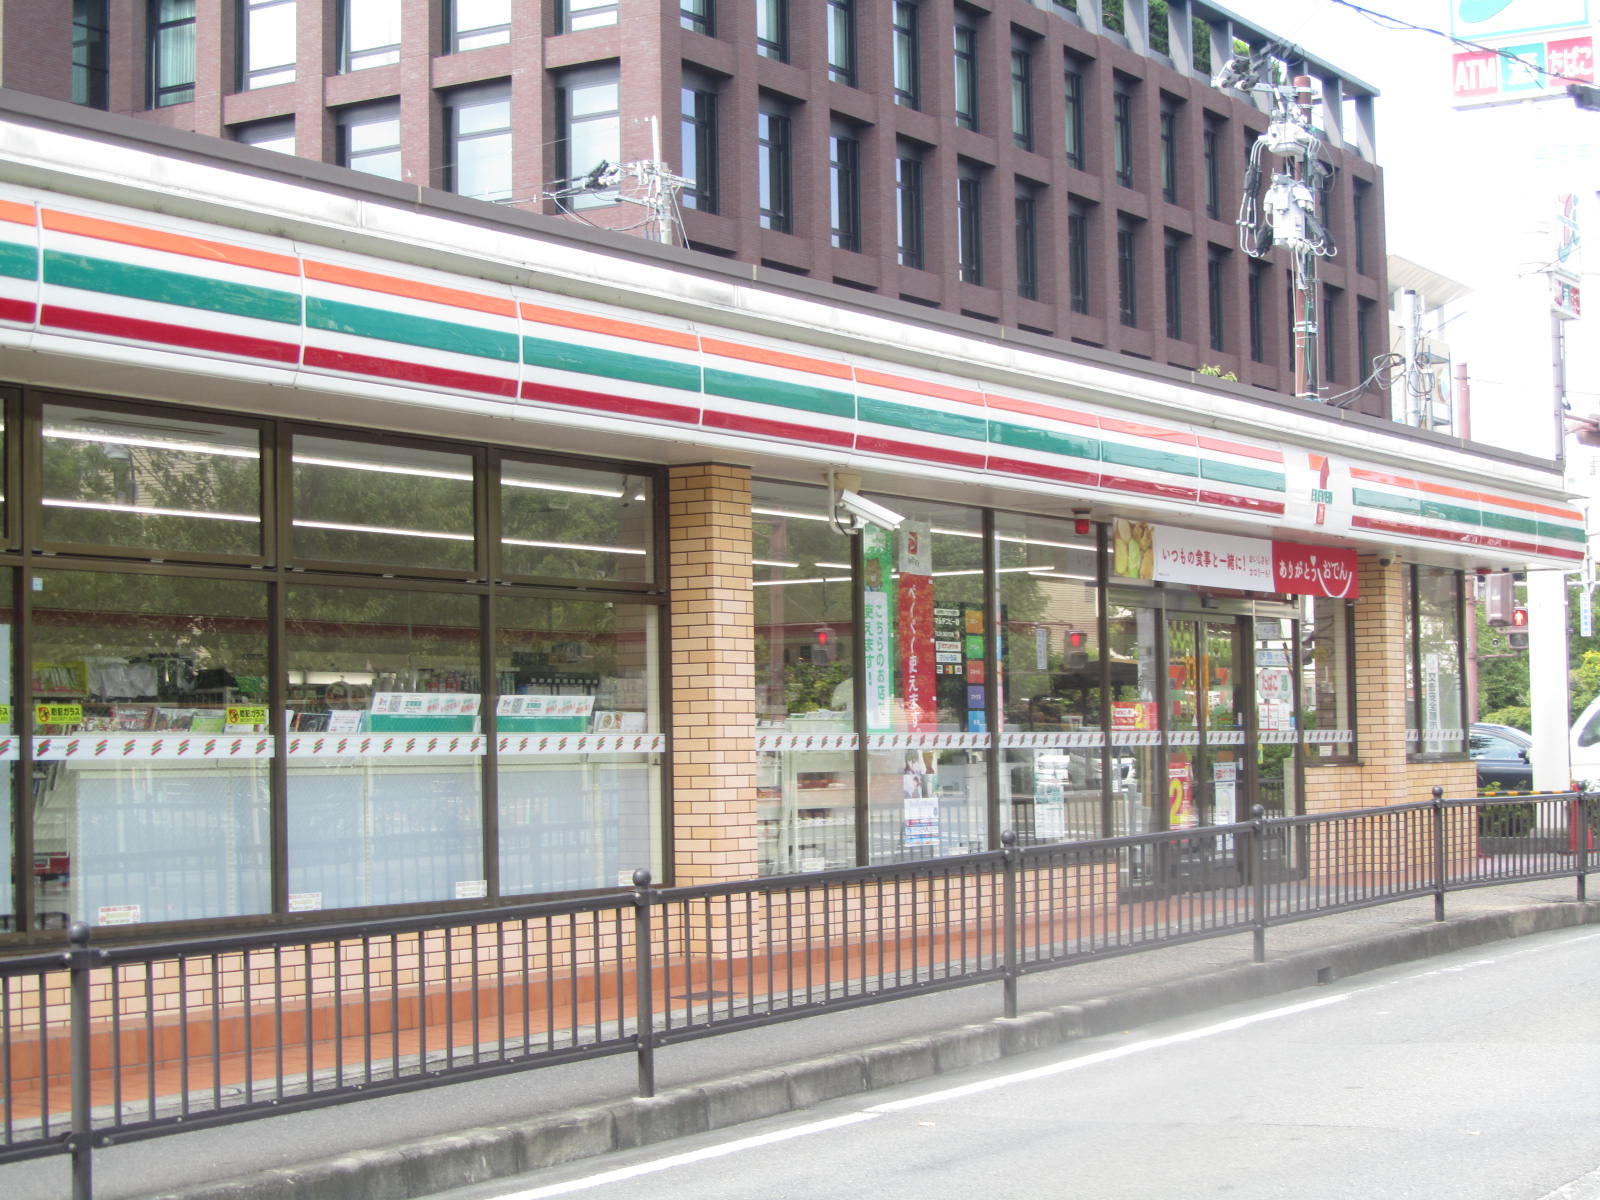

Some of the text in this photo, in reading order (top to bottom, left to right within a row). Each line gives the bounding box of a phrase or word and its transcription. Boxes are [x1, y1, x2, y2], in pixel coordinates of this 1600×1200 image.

[1454, 57, 1496, 91] ATM
[1548, 46, 1592, 77] たばこ
[1170, 779, 1184, 824] 2
